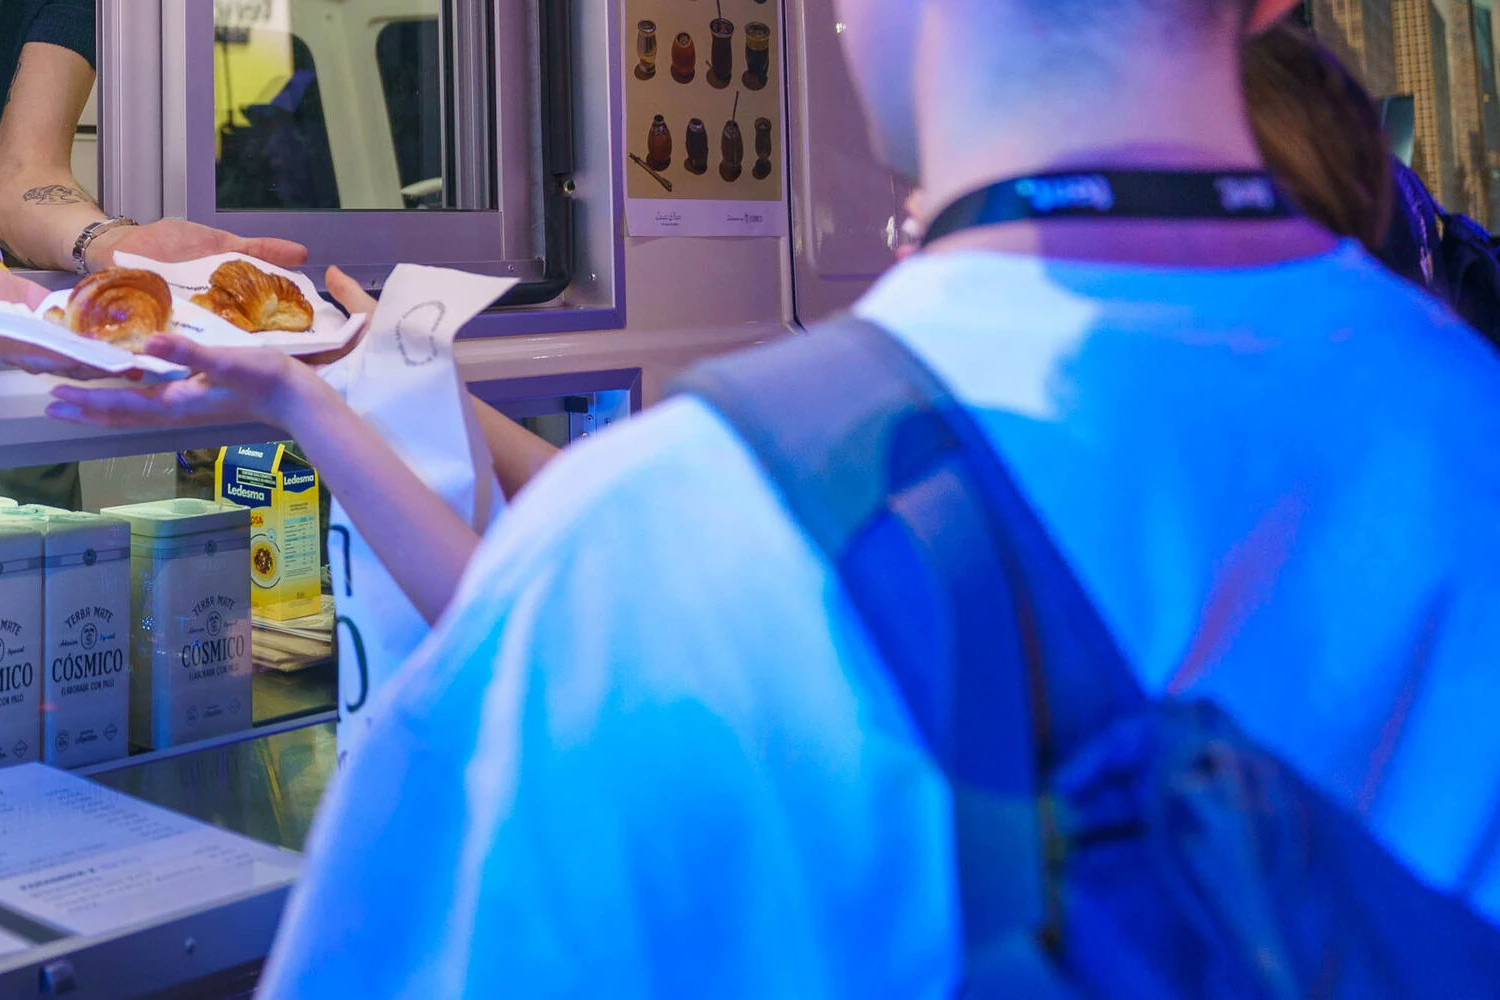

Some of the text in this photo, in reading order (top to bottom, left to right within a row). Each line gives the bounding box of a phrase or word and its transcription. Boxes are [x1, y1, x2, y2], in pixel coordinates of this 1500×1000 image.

[238, 446, 264, 458] Ledesma
[283, 473, 314, 486] Ledesma
[227, 483, 265, 501] Ledesma
[217, 594, 236, 611] MATE
[93, 606, 114, 624] MATE
[0, 618, 22, 637] MATE
[181, 634, 245, 668] CÓSMICO
[52, 648, 123, 683] CÓSMICO
